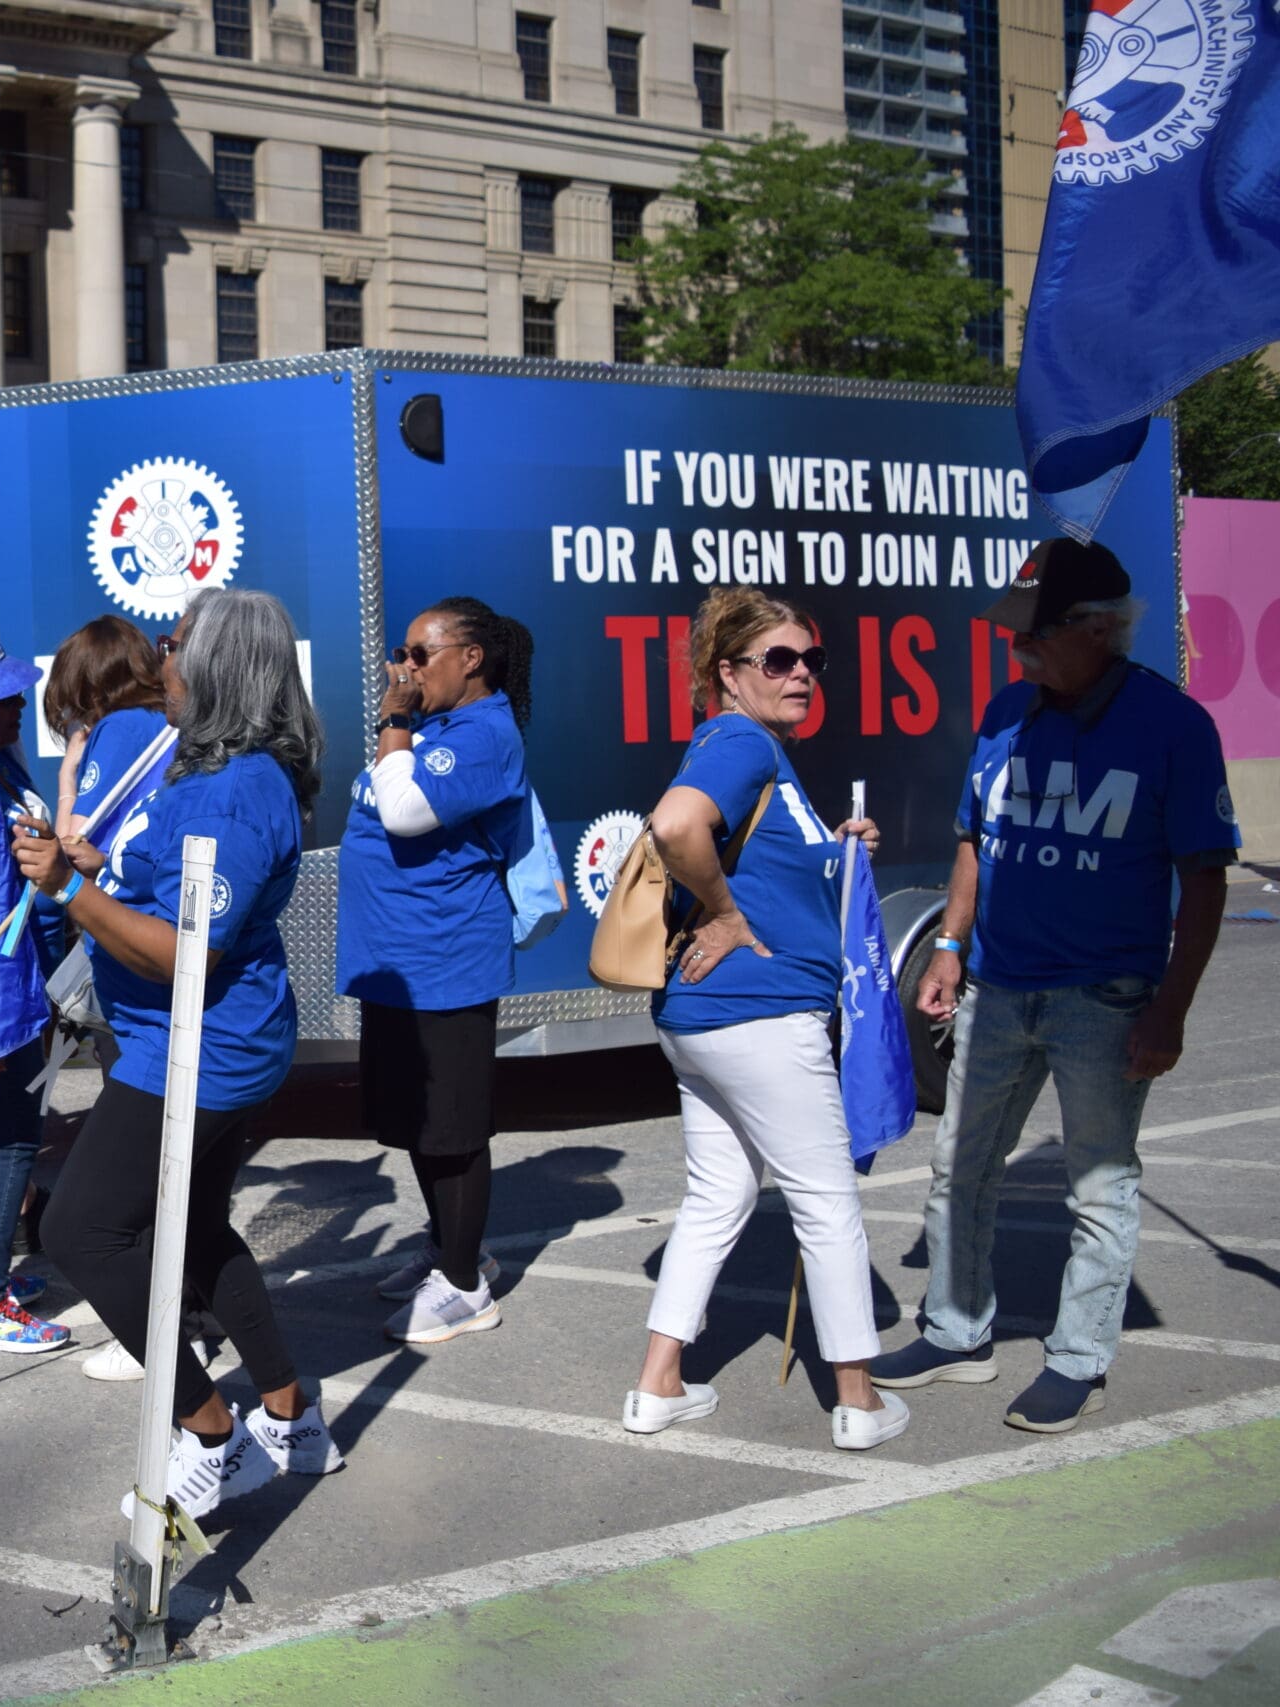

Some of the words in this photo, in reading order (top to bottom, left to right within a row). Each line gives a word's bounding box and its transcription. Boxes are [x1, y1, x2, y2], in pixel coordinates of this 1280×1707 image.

[1188, 0, 1227, 108] MACHINISTS
[1153, 108, 1195, 142] AND
[624, 449, 661, 505] IF
[673, 451, 756, 509] YOU
[768, 455, 872, 513] WERE
[882, 461, 1030, 520] WAITING
[551, 525, 637, 583] FOR
[651, 527, 679, 583] A
[691, 527, 786, 585] SIGN
[797, 531, 846, 586] TO
[858, 533, 938, 587] JOIN
[950, 536, 974, 588] A
[984, 538, 1040, 589] UN
[859, 615, 940, 735] IS
[863, 935, 891, 992] IAMAW
